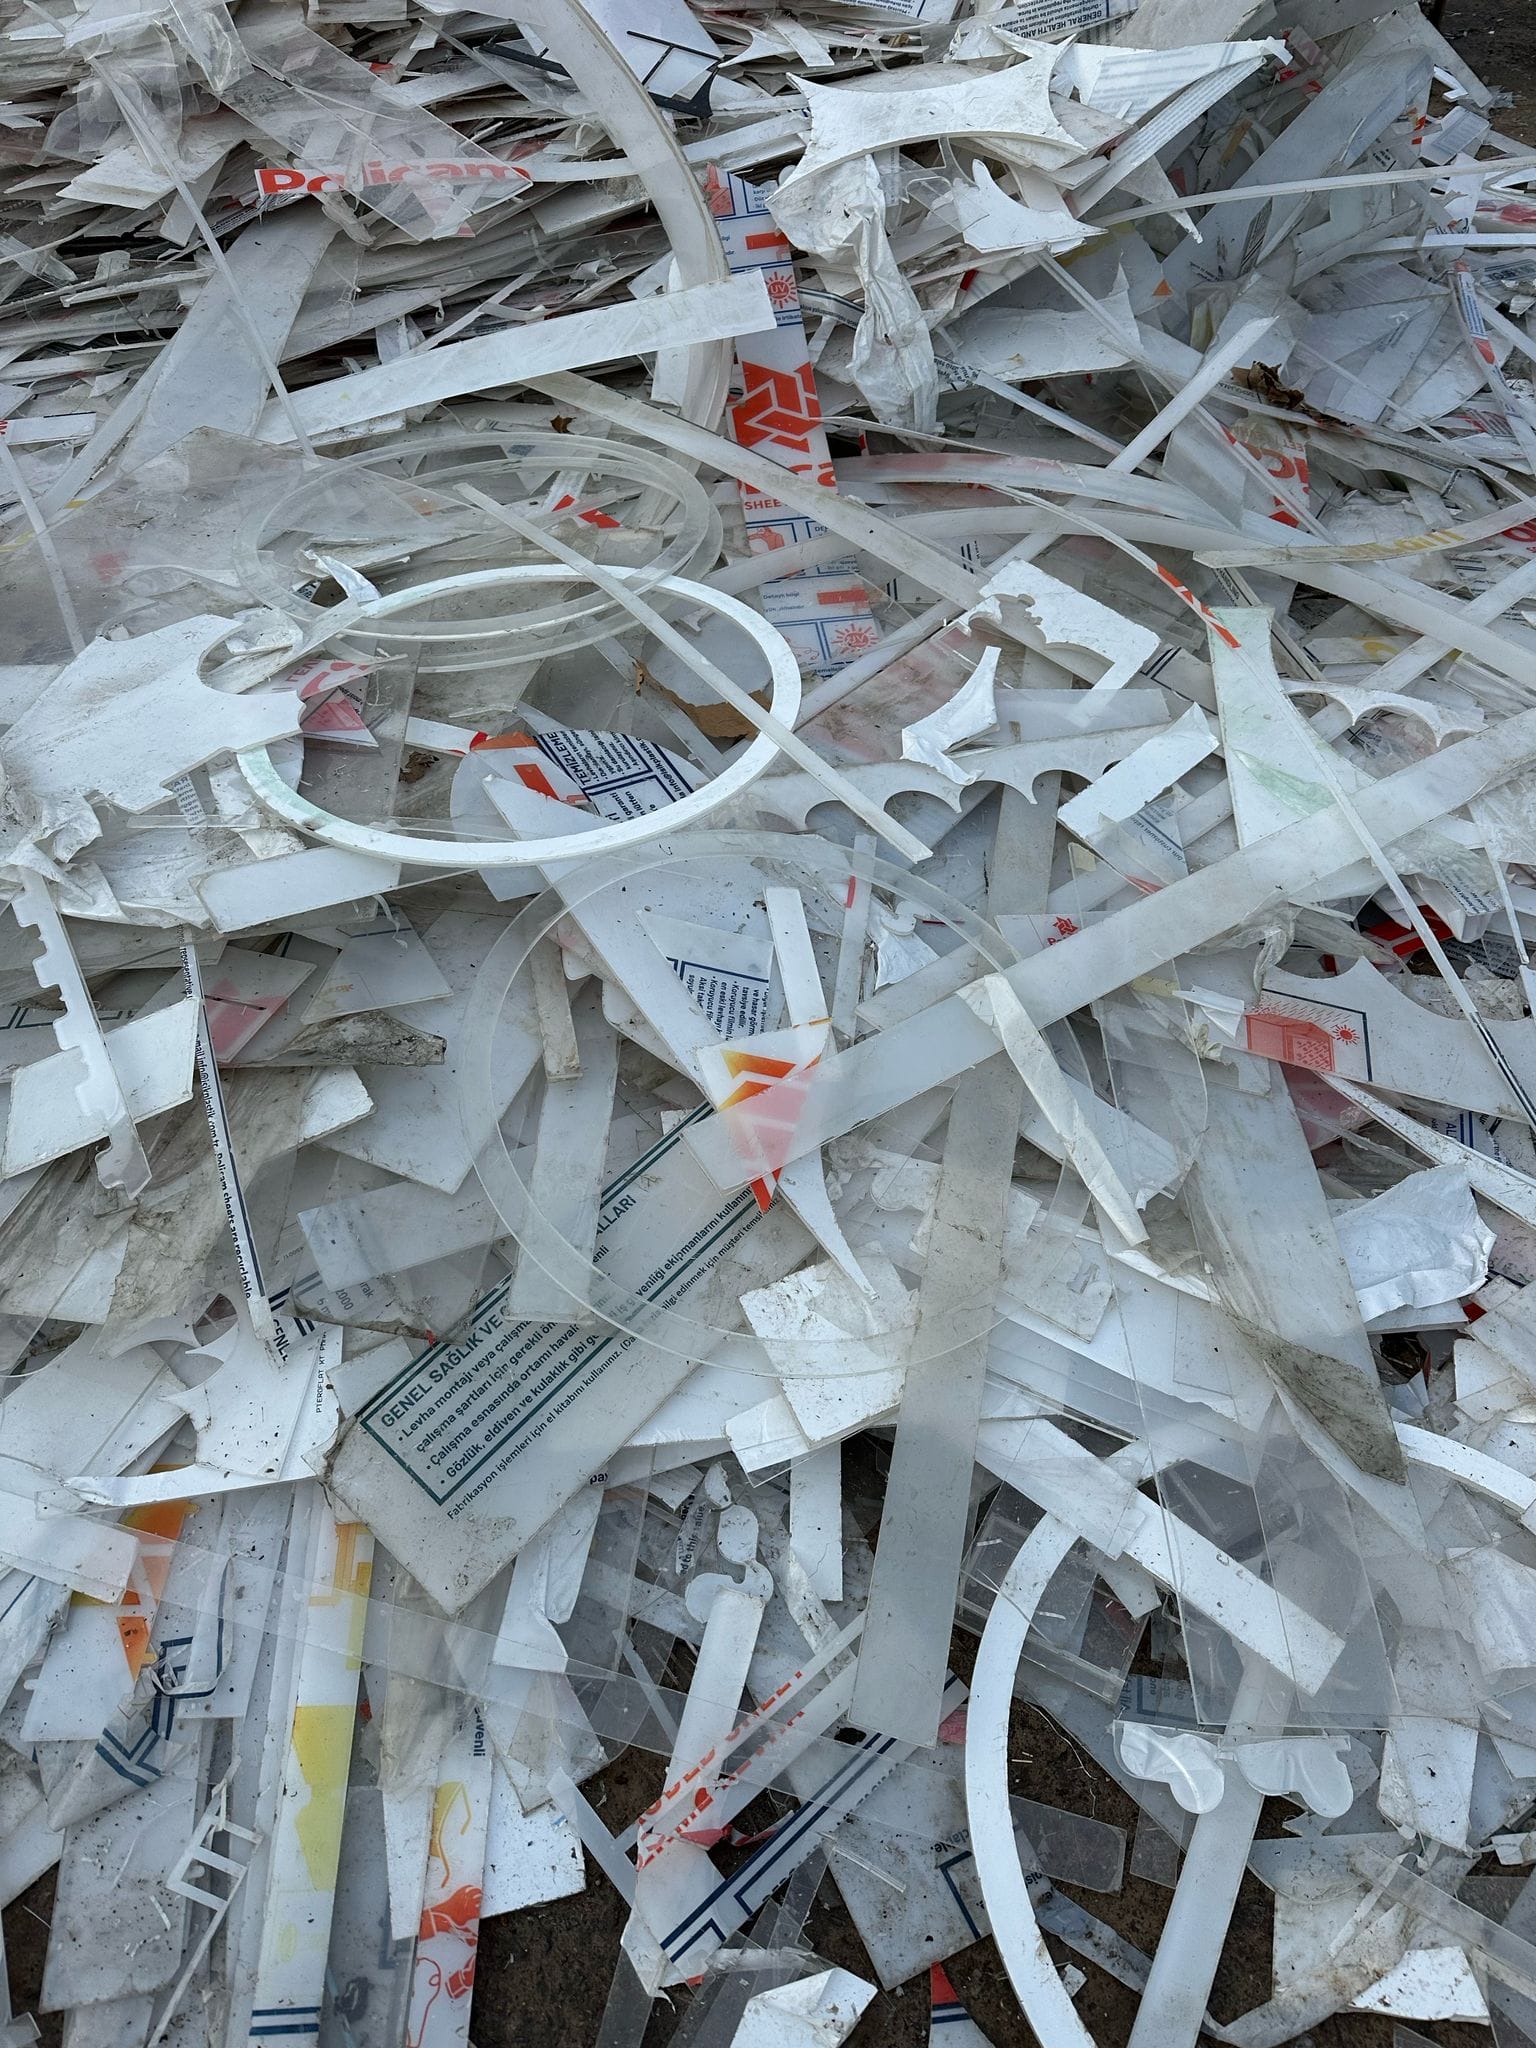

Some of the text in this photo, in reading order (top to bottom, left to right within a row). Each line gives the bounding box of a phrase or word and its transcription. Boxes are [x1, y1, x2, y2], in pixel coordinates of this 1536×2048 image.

[1036, 19, 1067, 34] HEALTH
[1066, 9, 1102, 25] GENERAL
[770, 284, 787, 294] UV
[545, 731, 590, 785] TEMİZLEME
[609, 791, 632, 816] garanti
[624, 790, 642, 811] lütfen
[698, 976, 707, 991] Aksi
[706, 978, 717, 1009] Koruyucu
[720, 981, 727, 990] en
[752, 989, 759, 997] ve
[718, 990, 726, 1004] eski
[728, 983, 739, 1014] Koruyucu
[737, 986, 749, 1028] tavsiye edilir.
[750, 997, 759, 1016] hasar
[725, 1015, 735, 1035] filmin
[445, 1443, 485, 1477] Gözlük,
[483, 1407, 521, 1442] eldiven
[518, 1394, 533, 1407] ve
[529, 1359, 569, 1396] kulaklık
[567, 1341, 587, 1362] gibi
[664, 1217, 719, 1270] ekipmanlarını
[380, 1313, 503, 1427] GENEL SAĞLIK VE
[446, 1470, 497, 1519] Fabrikasyon
[495, 1435, 532, 1471] işlemleri
[529, 1422, 547, 1438] için
[545, 1411, 556, 1423] el
[552, 1385, 585, 1415] kitabını
[581, 1350, 622, 1386] kullanınız.
[675, 1266, 707, 1297] edinmek
[703, 1255, 719, 1269] için
[717, 1229, 744, 1256] müşteri
[401, 1406, 436, 1437] Levha
[434, 1371, 473, 1408] montajı
[471, 1350, 496, 1372] veya
[416, 1414, 456, 1452] çalışma
[454, 1379, 492, 1415] şartları
[488, 1362, 508, 1382] için
[508, 1330, 543, 1365] gerekli
[429, 1426, 472, 1465] Çalışma
[470, 1379, 521, 1427] esnasında
[519, 1349, 552, 1381] ortamı
[684, 1532, 699, 1552] this
